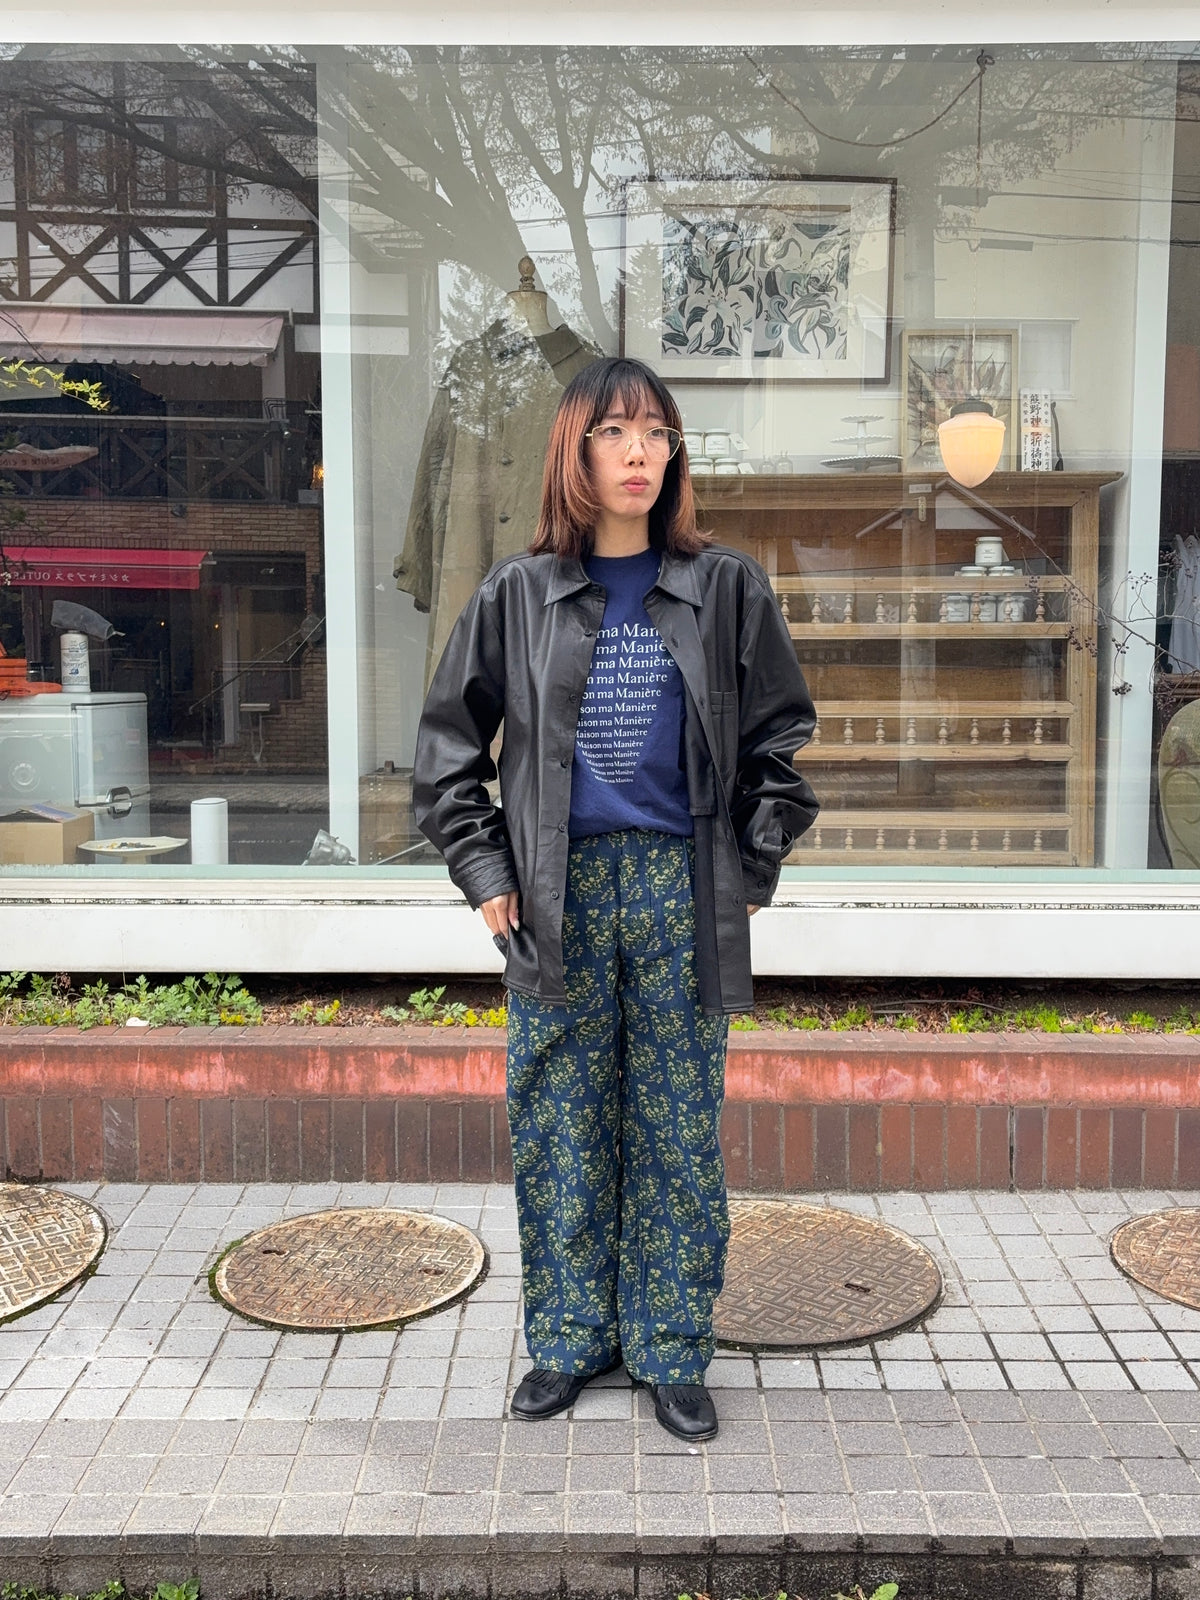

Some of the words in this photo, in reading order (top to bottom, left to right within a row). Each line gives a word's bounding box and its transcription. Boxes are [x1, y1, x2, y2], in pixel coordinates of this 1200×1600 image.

[597, 627, 618, 638] ma
[596, 645, 617, 654] ma
[596, 660, 615, 669] ma
[619, 656, 674, 668] Manière
[596, 675, 614, 684] ma
[617, 672, 668, 684] Manière
[616, 688, 661, 698] Manière
[615, 702, 657, 712] Manière
[614, 716, 652, 725] Manière
[613, 728, 648, 737] Manière
[577, 741, 601, 749] Maison
[613, 740, 644, 748] Manière
[582, 750, 604, 758] Maison
[613, 750, 640, 758] Manière
